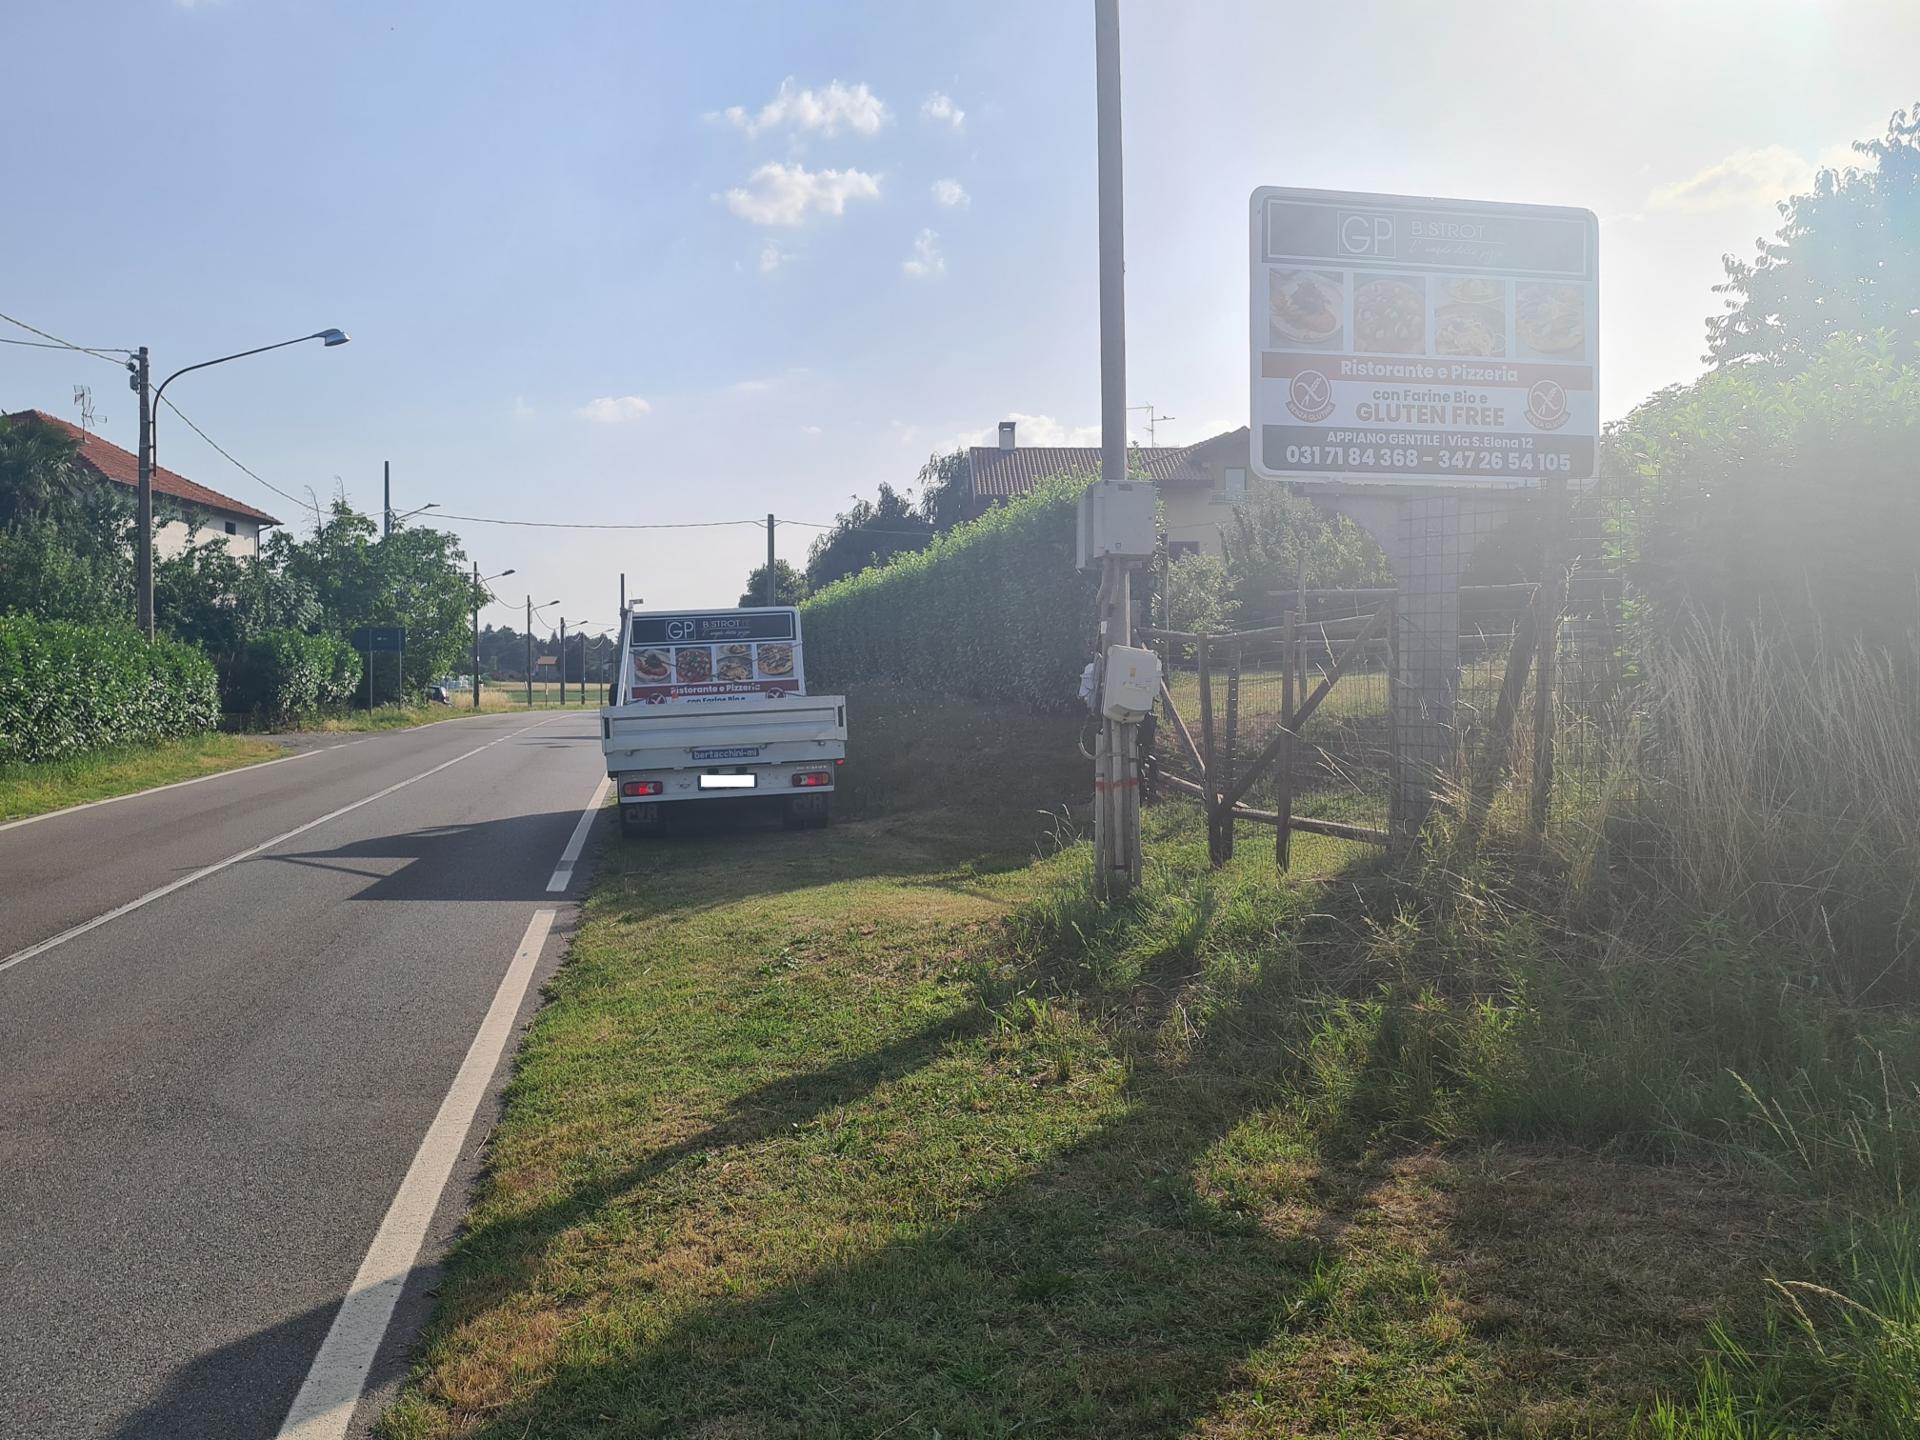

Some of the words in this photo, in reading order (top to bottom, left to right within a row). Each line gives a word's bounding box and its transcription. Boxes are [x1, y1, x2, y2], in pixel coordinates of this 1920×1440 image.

[1342, 215, 1392, 254] GP
[1411, 220, 1486, 240] BSTROT
[1341, 360, 1434, 378] Ristorante
[1438, 368, 1448, 378] e
[1451, 364, 1518, 381] Pizzeria
[1373, 390, 1400, 401] con
[1403, 389, 1450, 403] Farine
[1454, 390, 1476, 404] Bio
[1479, 394, 1488, 404] e
[1356, 402, 1446, 424] GLUTEN
[1452, 406, 1504, 426] FREE
[1327, 432, 1386, 444] APPIANO
[1388, 433, 1440, 445] GENTILE
[1448, 435, 1470, 446] Via
[1472, 436, 1519, 448] S.Elena
[1521, 438, 1534, 448] 12
[1286, 445, 1320, 464] 031
[1325, 447, 1344, 465] 71
[1348, 448, 1375, 466] 84
[1380, 449, 1418, 467] 368
[1438, 450, 1475, 468] 347
[1479, 451, 1503, 469] 26
[1508, 452, 1534, 470] 54
[1537, 453, 1571, 471] 105
[667, 621, 694, 639] GP
